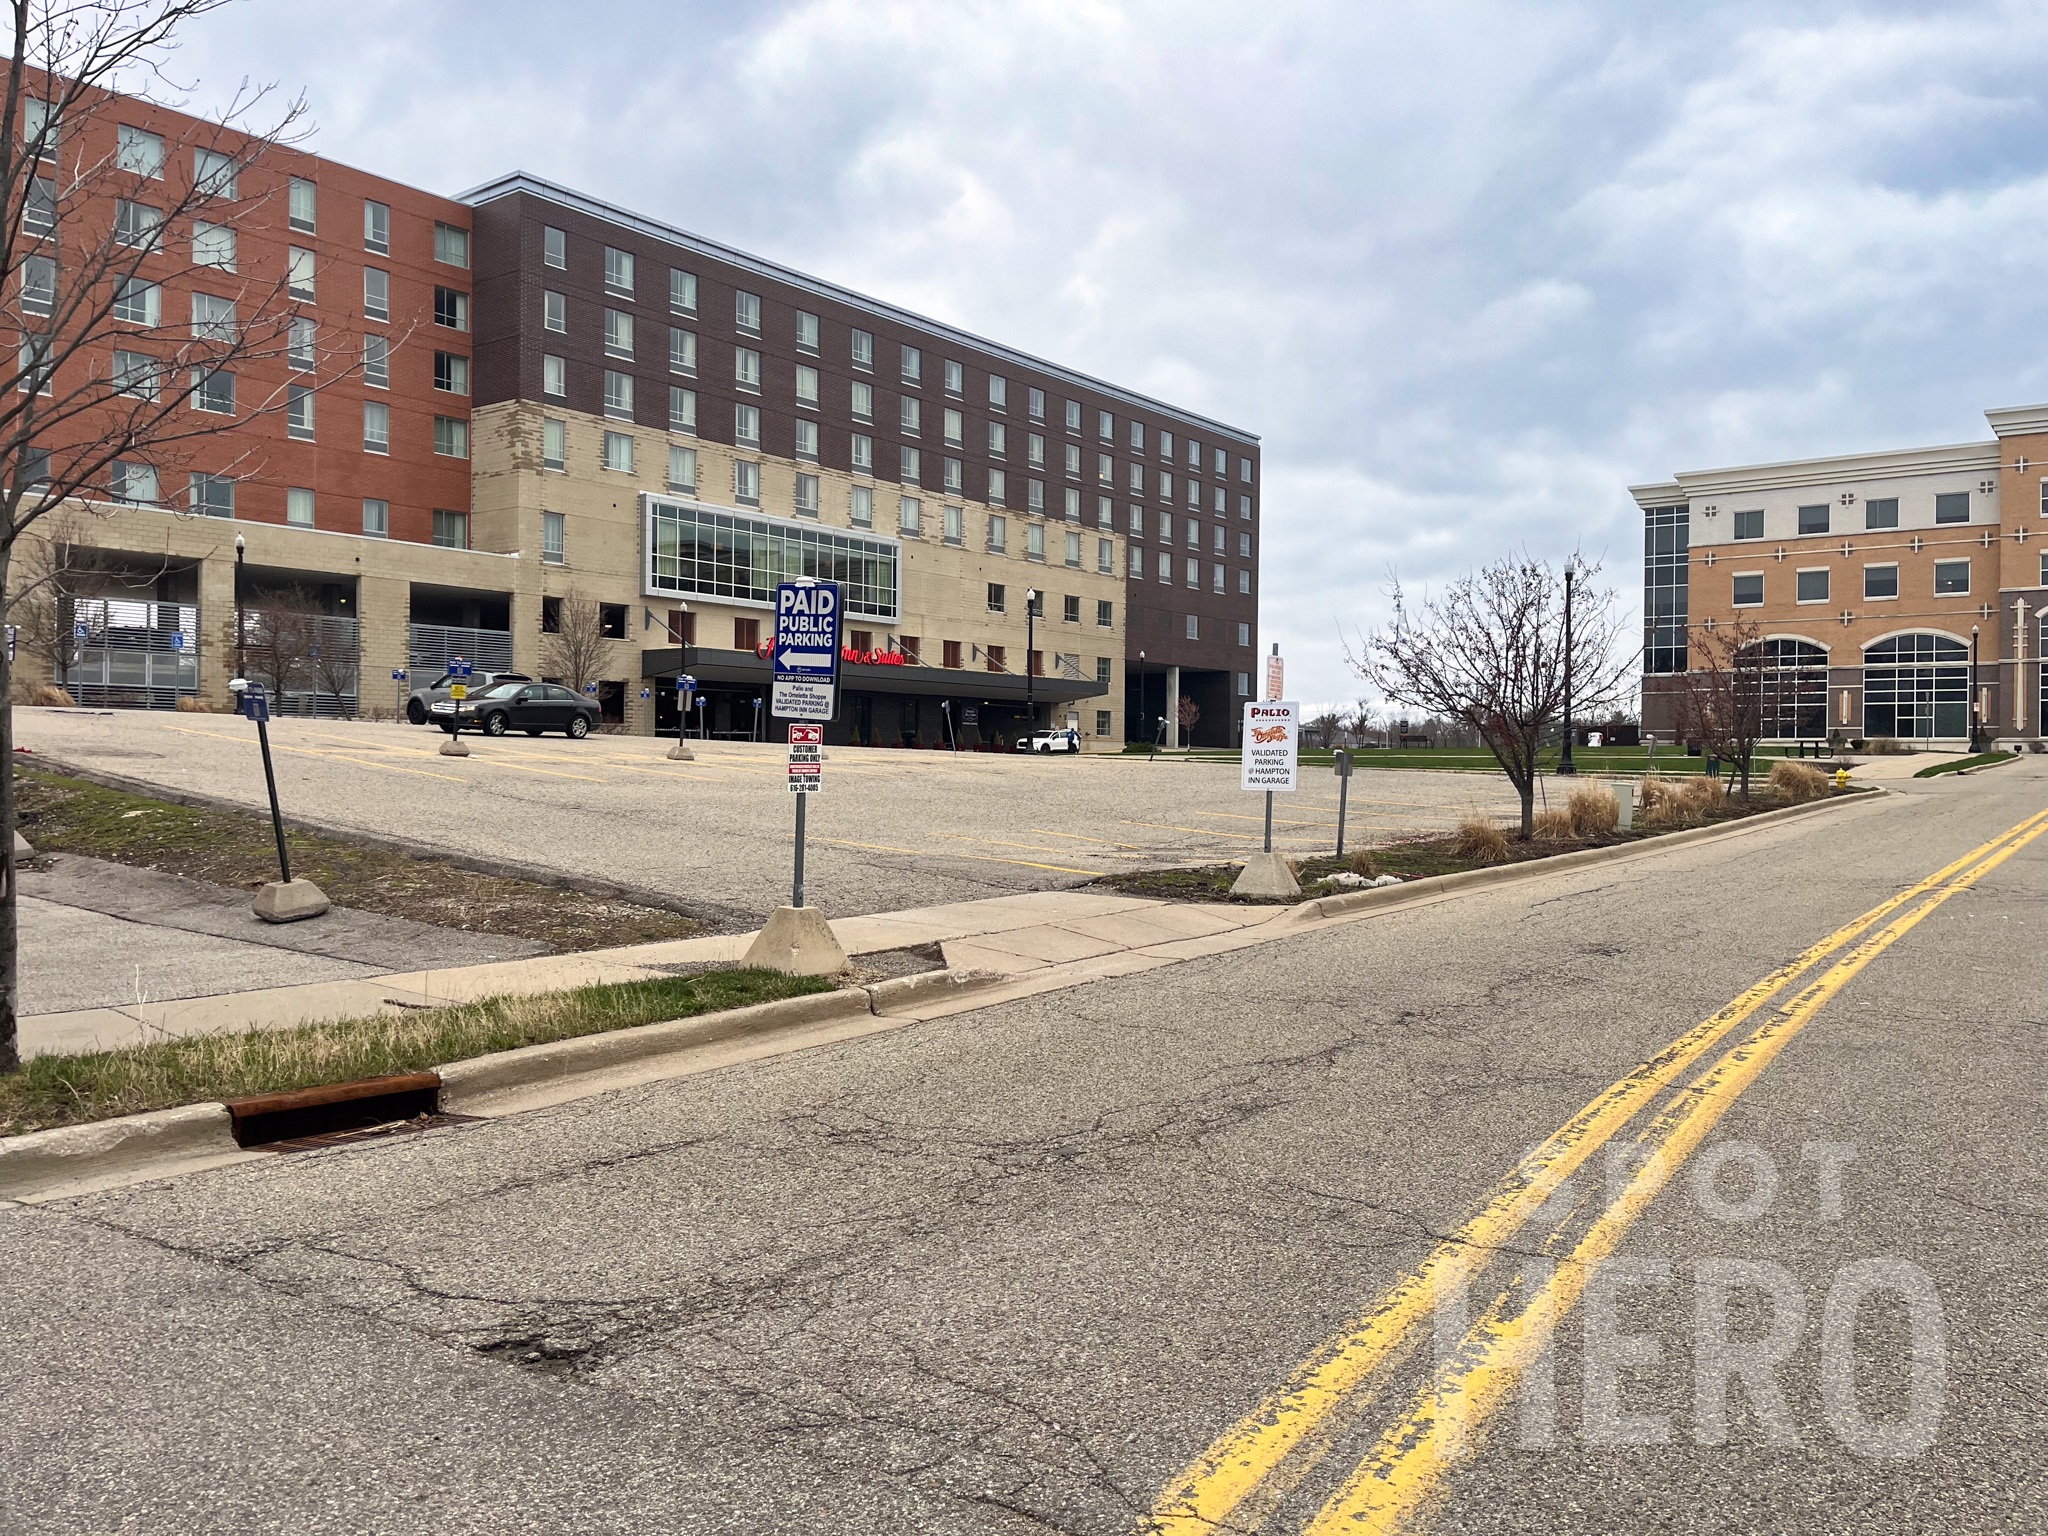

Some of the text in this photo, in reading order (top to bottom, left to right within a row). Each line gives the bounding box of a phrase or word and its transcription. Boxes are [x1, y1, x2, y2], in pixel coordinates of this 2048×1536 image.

[780, 589, 835, 615] PAID
[779, 616, 834, 632] PUBLIC
[778, 632, 833, 647] PARKING
[871, 647, 905, 666] Suites
[775, 698, 801, 706] VALIDATED
[824, 701, 830, 709] @
[1251, 707, 1290, 718] PALIO
[792, 745, 818, 753] CUSTOMER
[1251, 749, 1289, 757] VALIDATED
[789, 754, 820, 762] PARKING ONLY
[1254, 758, 1284, 766] PARKING
[1255, 767, 1290, 775] HAMPTON
[788, 775, 820, 783] IMAGE TOWING
[1261, 777, 1290, 785] GARAGE
